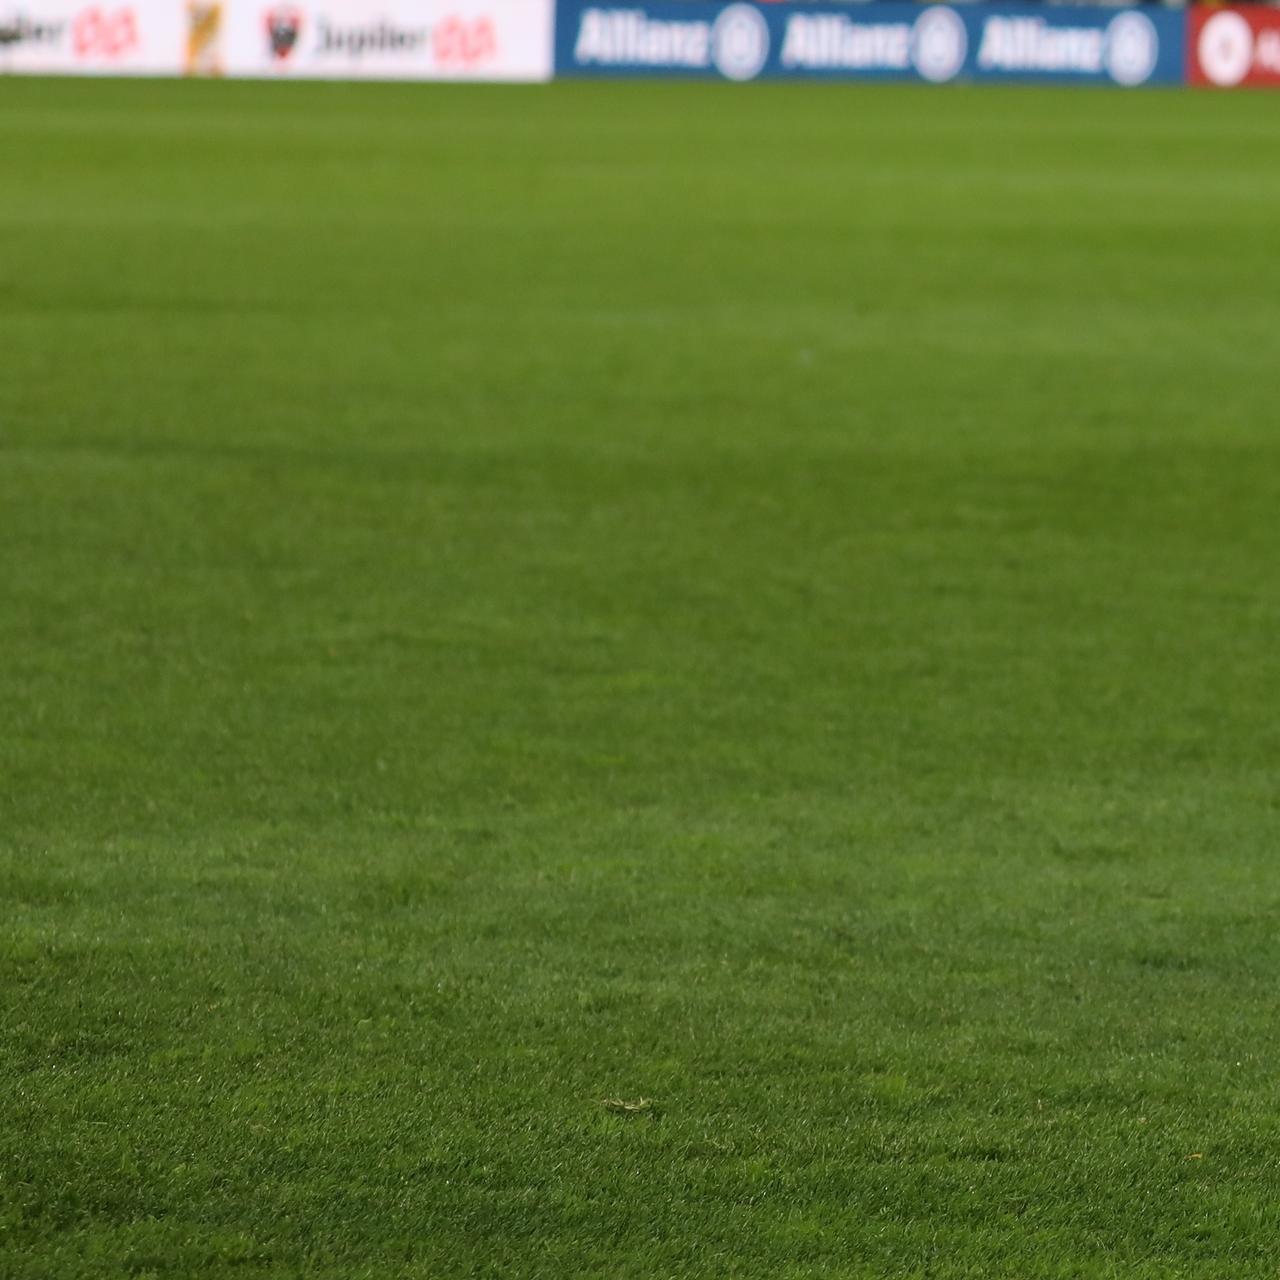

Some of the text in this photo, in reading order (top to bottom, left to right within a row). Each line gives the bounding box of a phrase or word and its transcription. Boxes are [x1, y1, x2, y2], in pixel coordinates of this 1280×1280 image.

[575, 7, 710, 67] Allianz
[782, 12, 910, 69] Allianz
[978, 14, 1103, 72] Allianz
